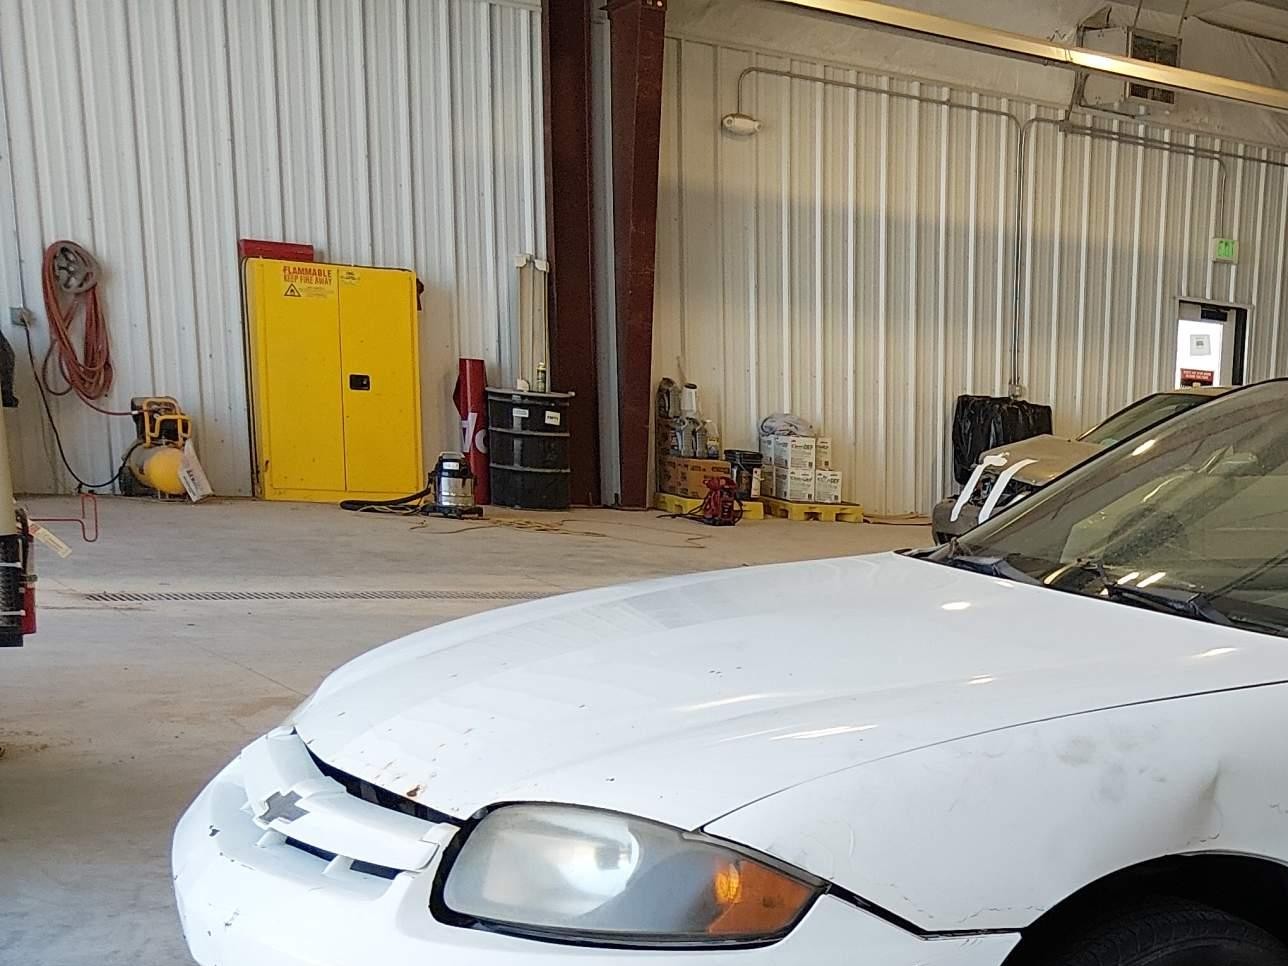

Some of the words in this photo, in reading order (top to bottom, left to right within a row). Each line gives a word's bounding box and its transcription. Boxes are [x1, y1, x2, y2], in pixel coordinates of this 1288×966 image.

[283, 266, 332, 278] FLAMMABLE
[284, 274, 298, 283] KEEP
[300, 275, 313, 285] FIRE
[315, 276, 332, 286] AWAY
